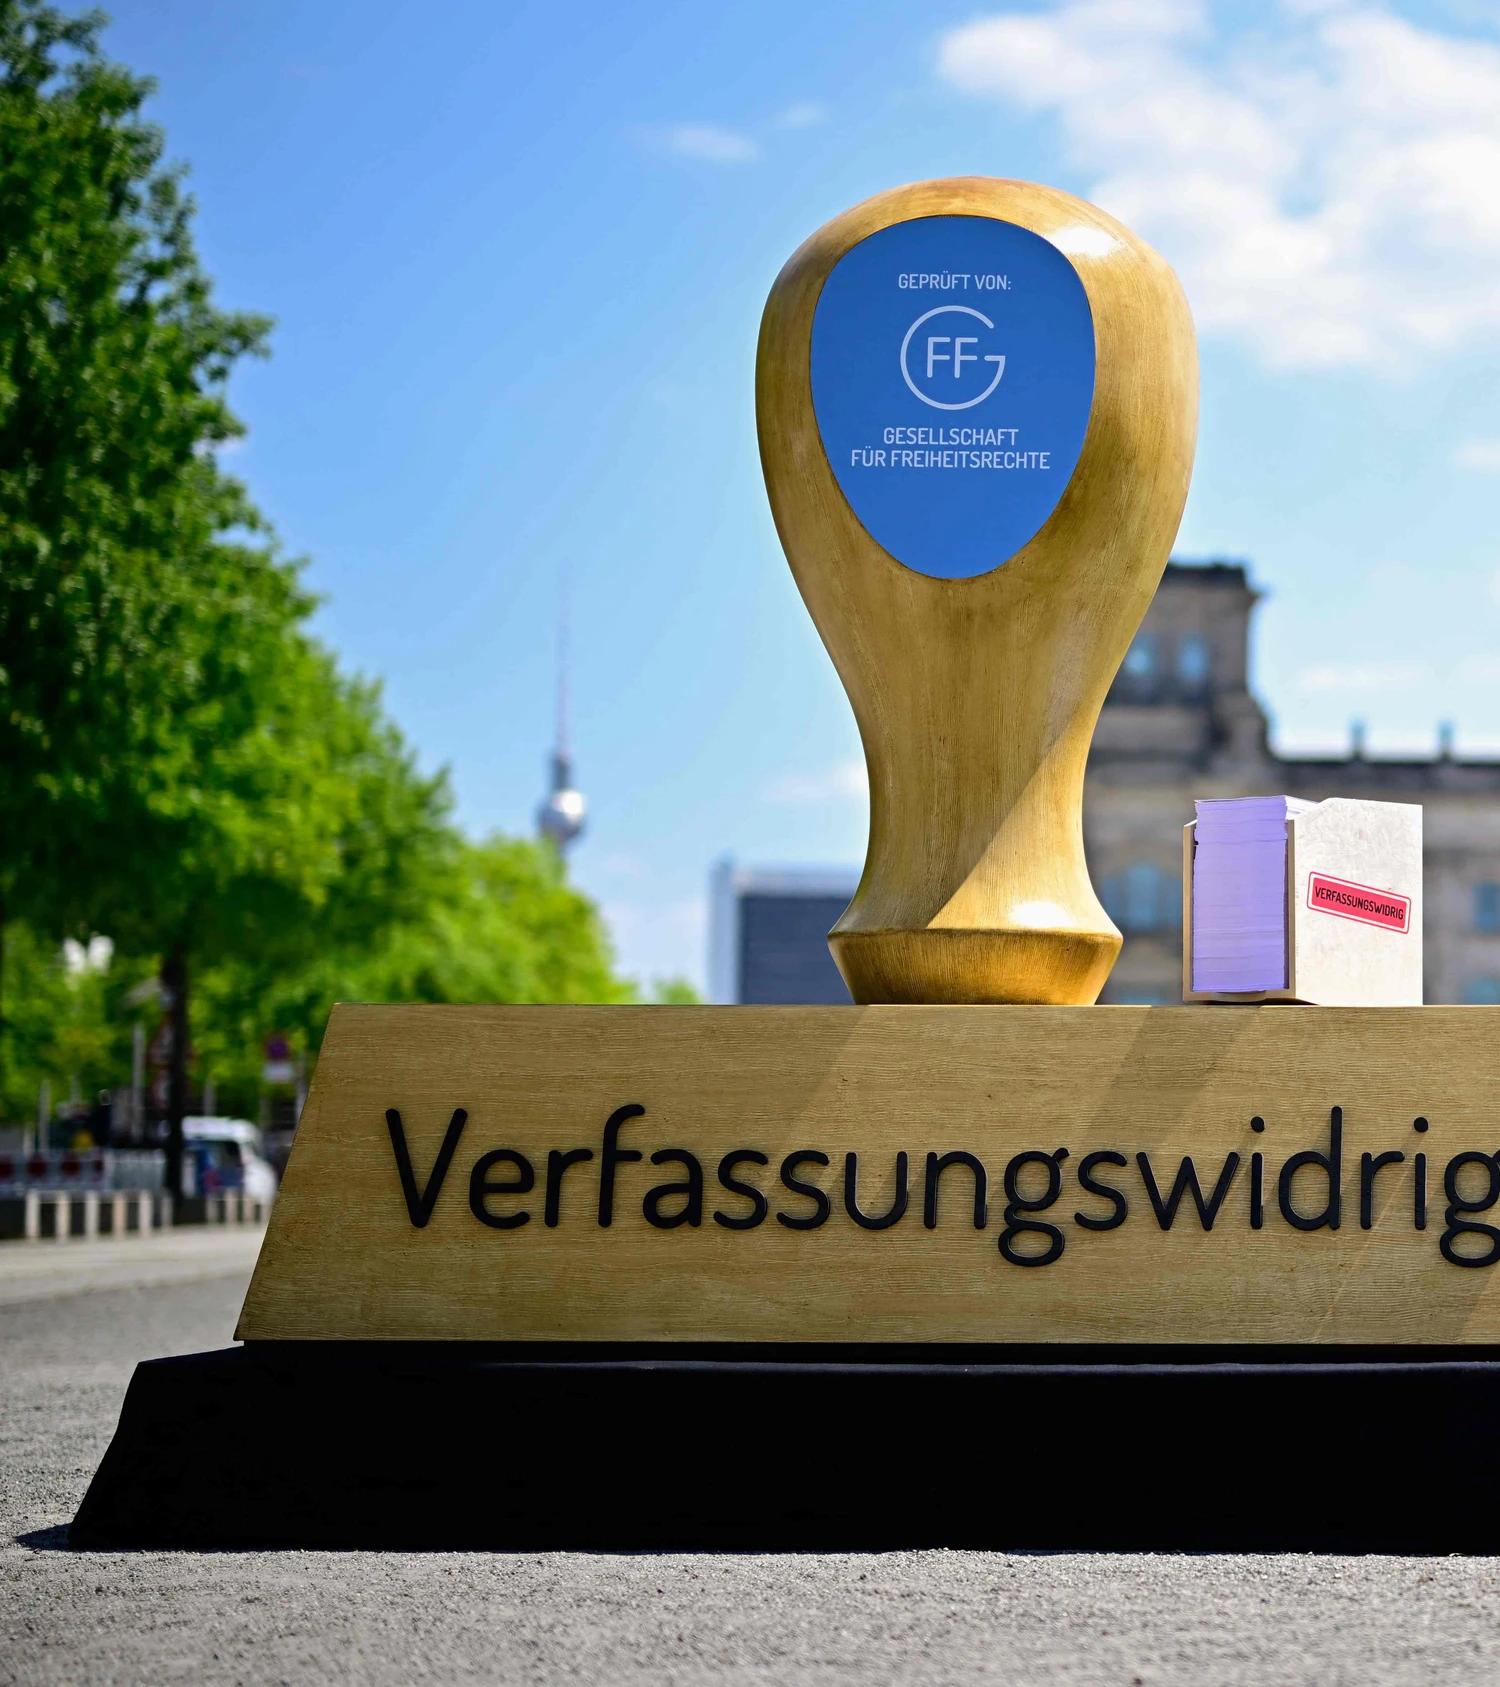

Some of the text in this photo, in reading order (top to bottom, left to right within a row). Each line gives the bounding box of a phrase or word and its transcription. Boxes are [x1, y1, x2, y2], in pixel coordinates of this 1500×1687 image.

[898, 271, 1012, 291] GEPRÜFT VON:
[883, 427, 1019, 446] GESELLSCHAFT
[851, 446, 1051, 470] FÜR FREIHEITSRECHTE
[1315, 885, 1404, 920] VERFASSUNGSWIDRIG
